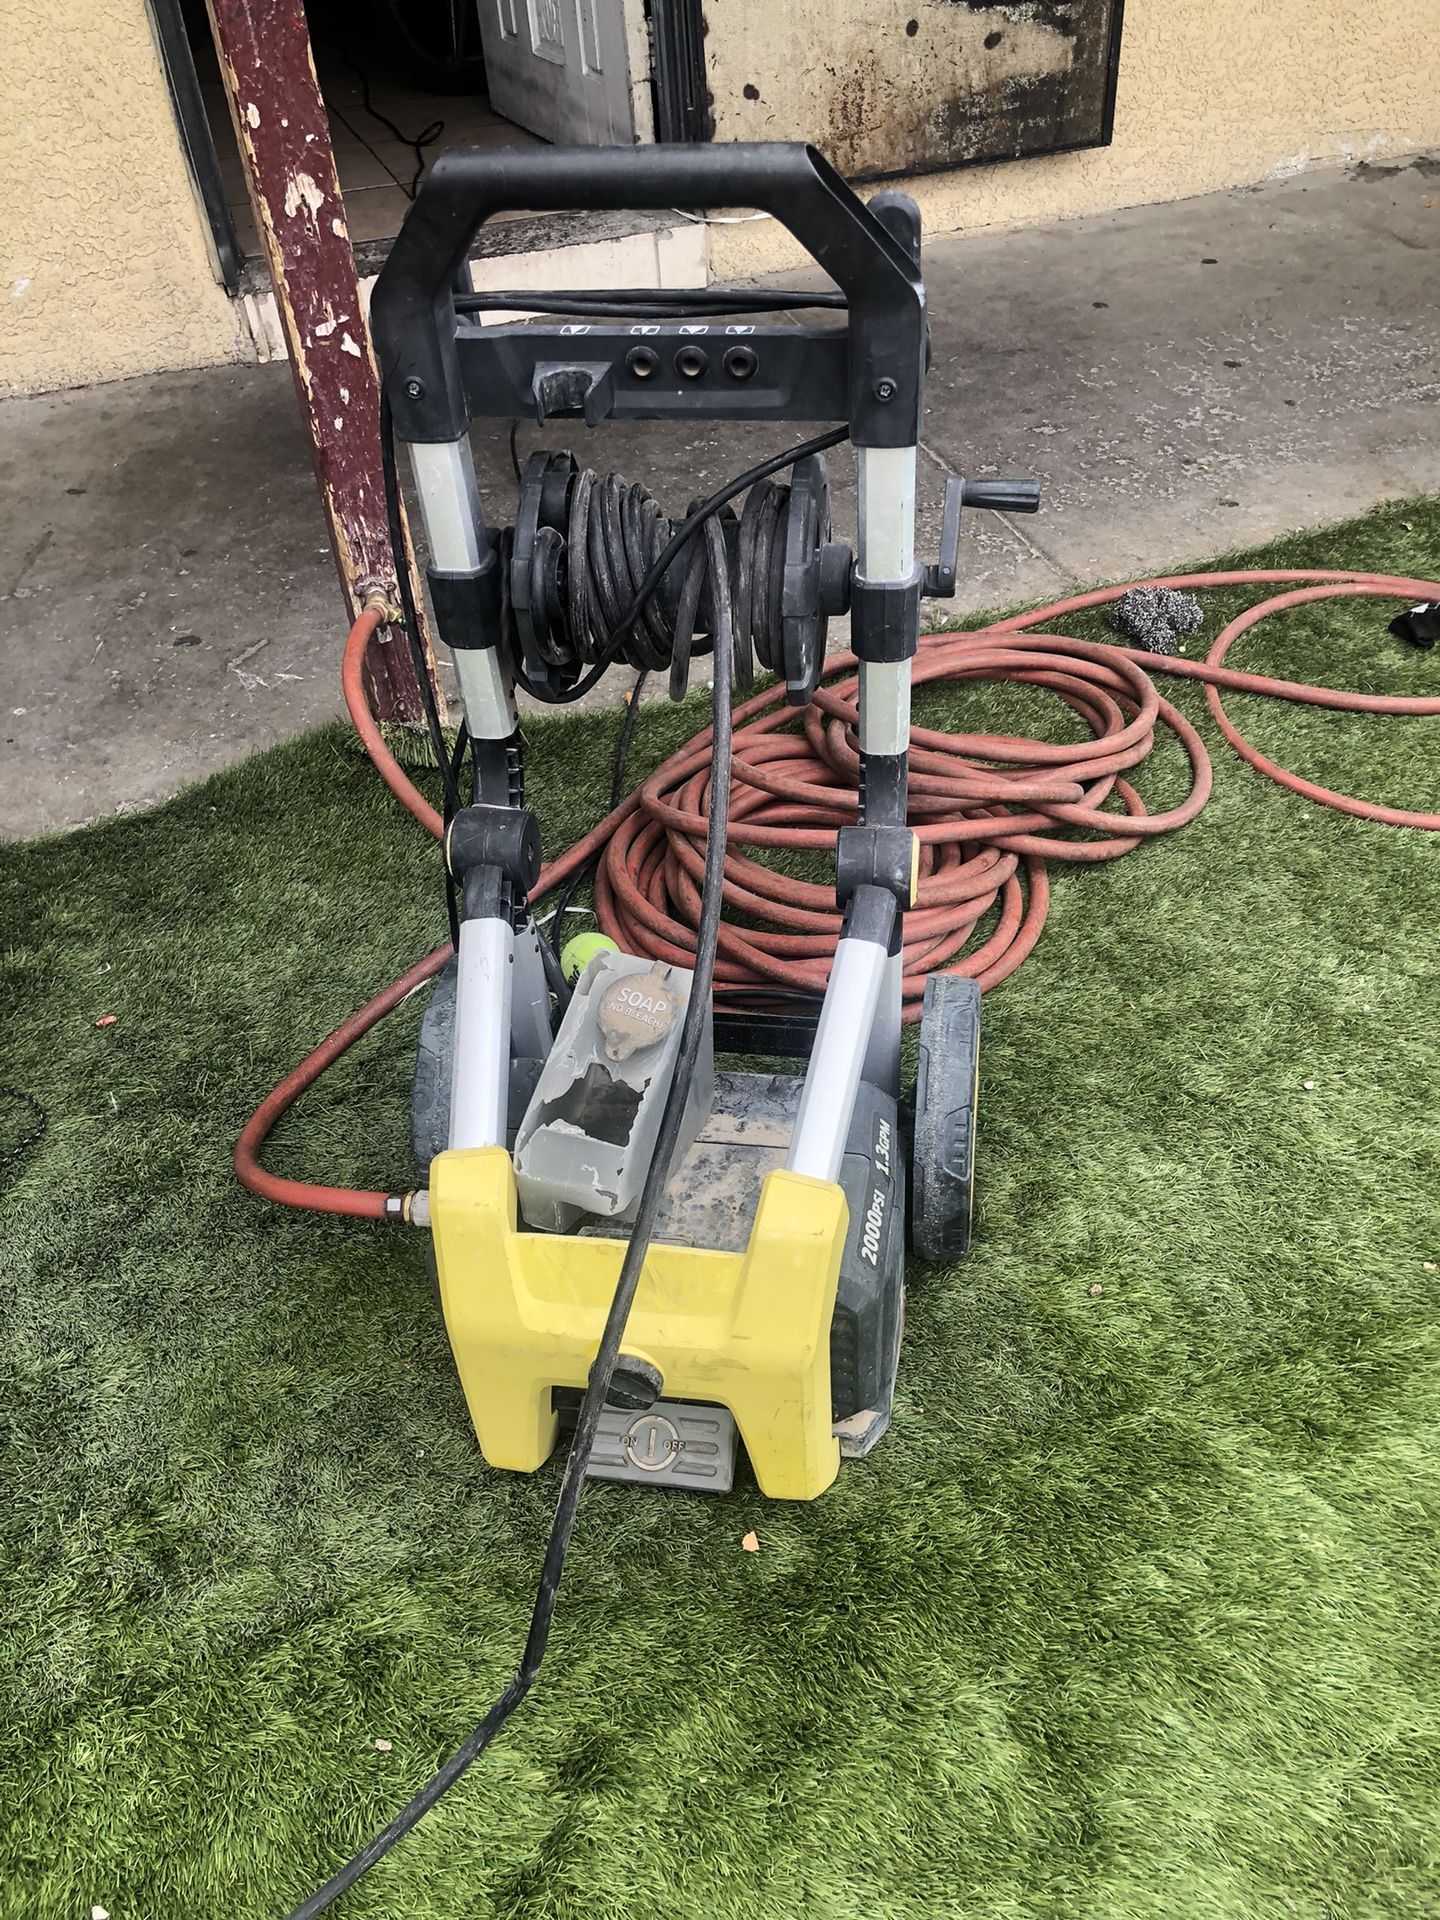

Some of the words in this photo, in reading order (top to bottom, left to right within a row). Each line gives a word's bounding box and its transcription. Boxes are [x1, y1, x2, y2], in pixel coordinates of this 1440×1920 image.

[617, 988, 666, 1013] SOAP
[861, 1188, 886, 1266] 2000PSI
[876, 1118, 891, 1176] 1.3GPM
[621, 1436, 638, 1446] ON
[663, 1440, 686, 1451] OFF
